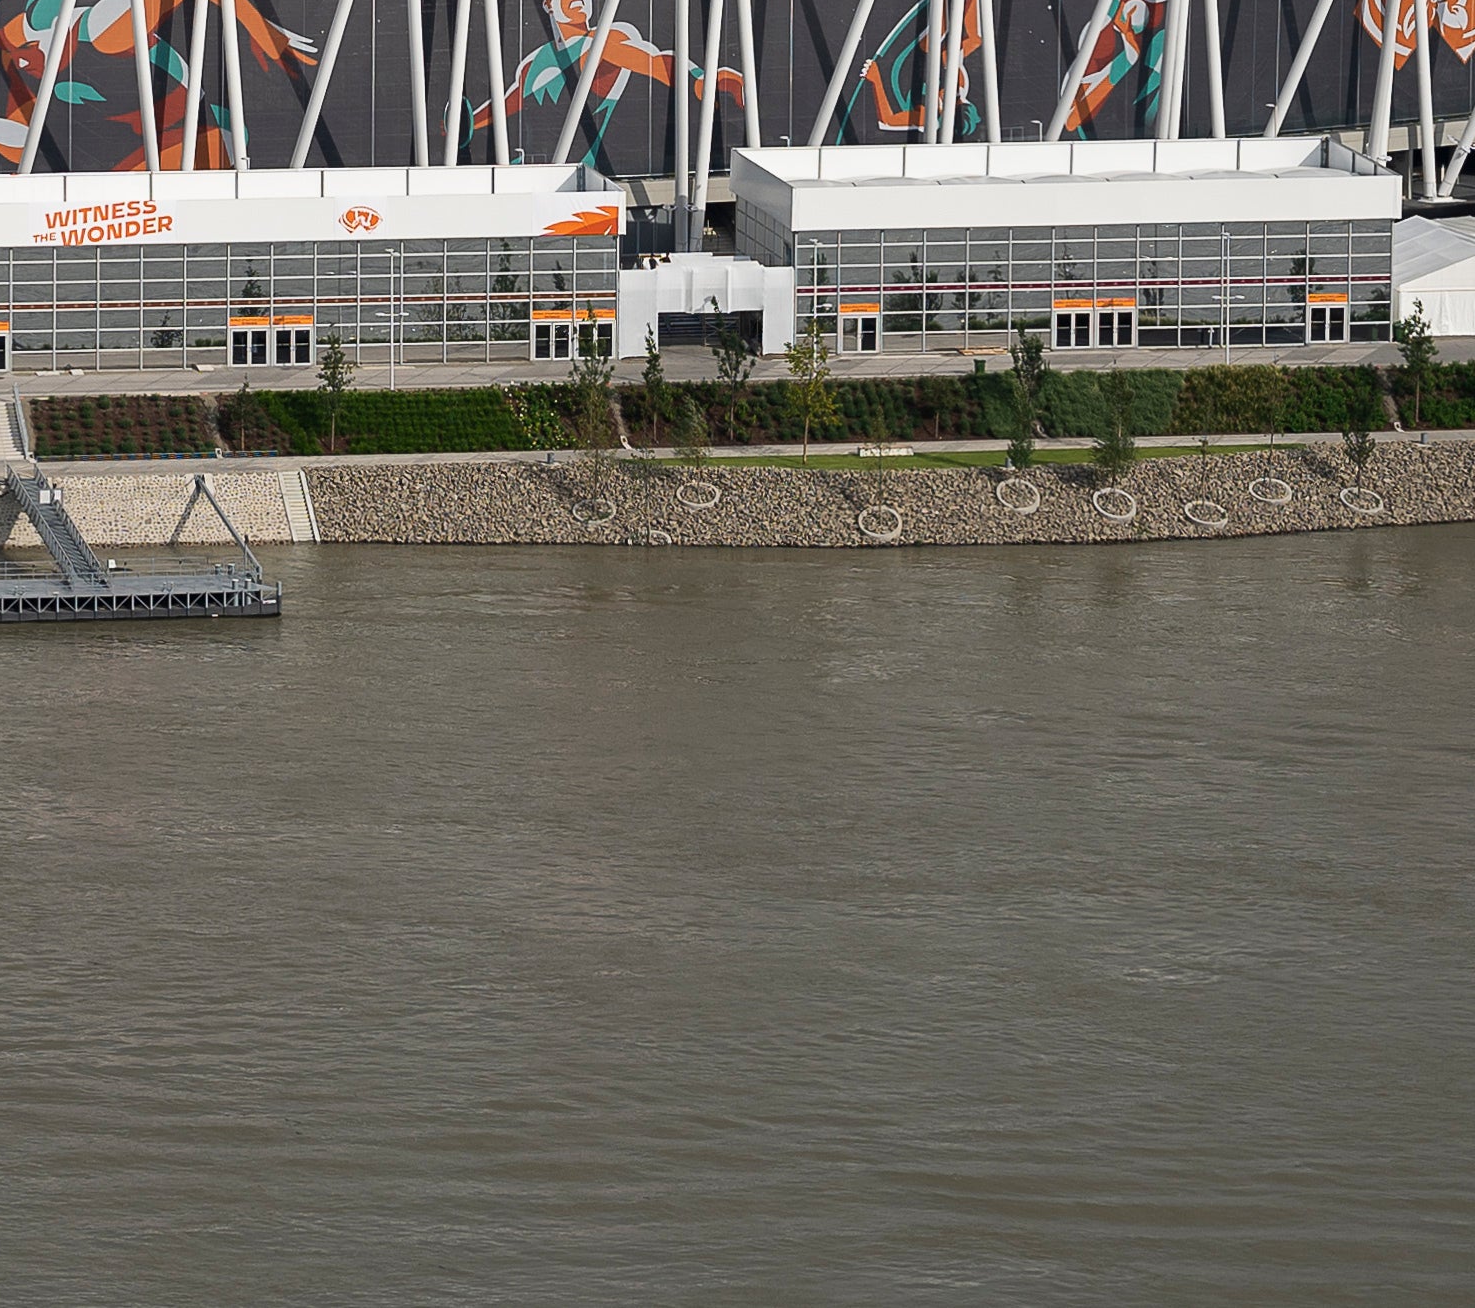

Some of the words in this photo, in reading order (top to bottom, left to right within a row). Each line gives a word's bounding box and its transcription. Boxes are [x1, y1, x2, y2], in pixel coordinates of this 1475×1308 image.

[45, 200, 157, 229] WITNESS
[32, 232, 57, 244] THE
[60, 215, 173, 246] WONDER
